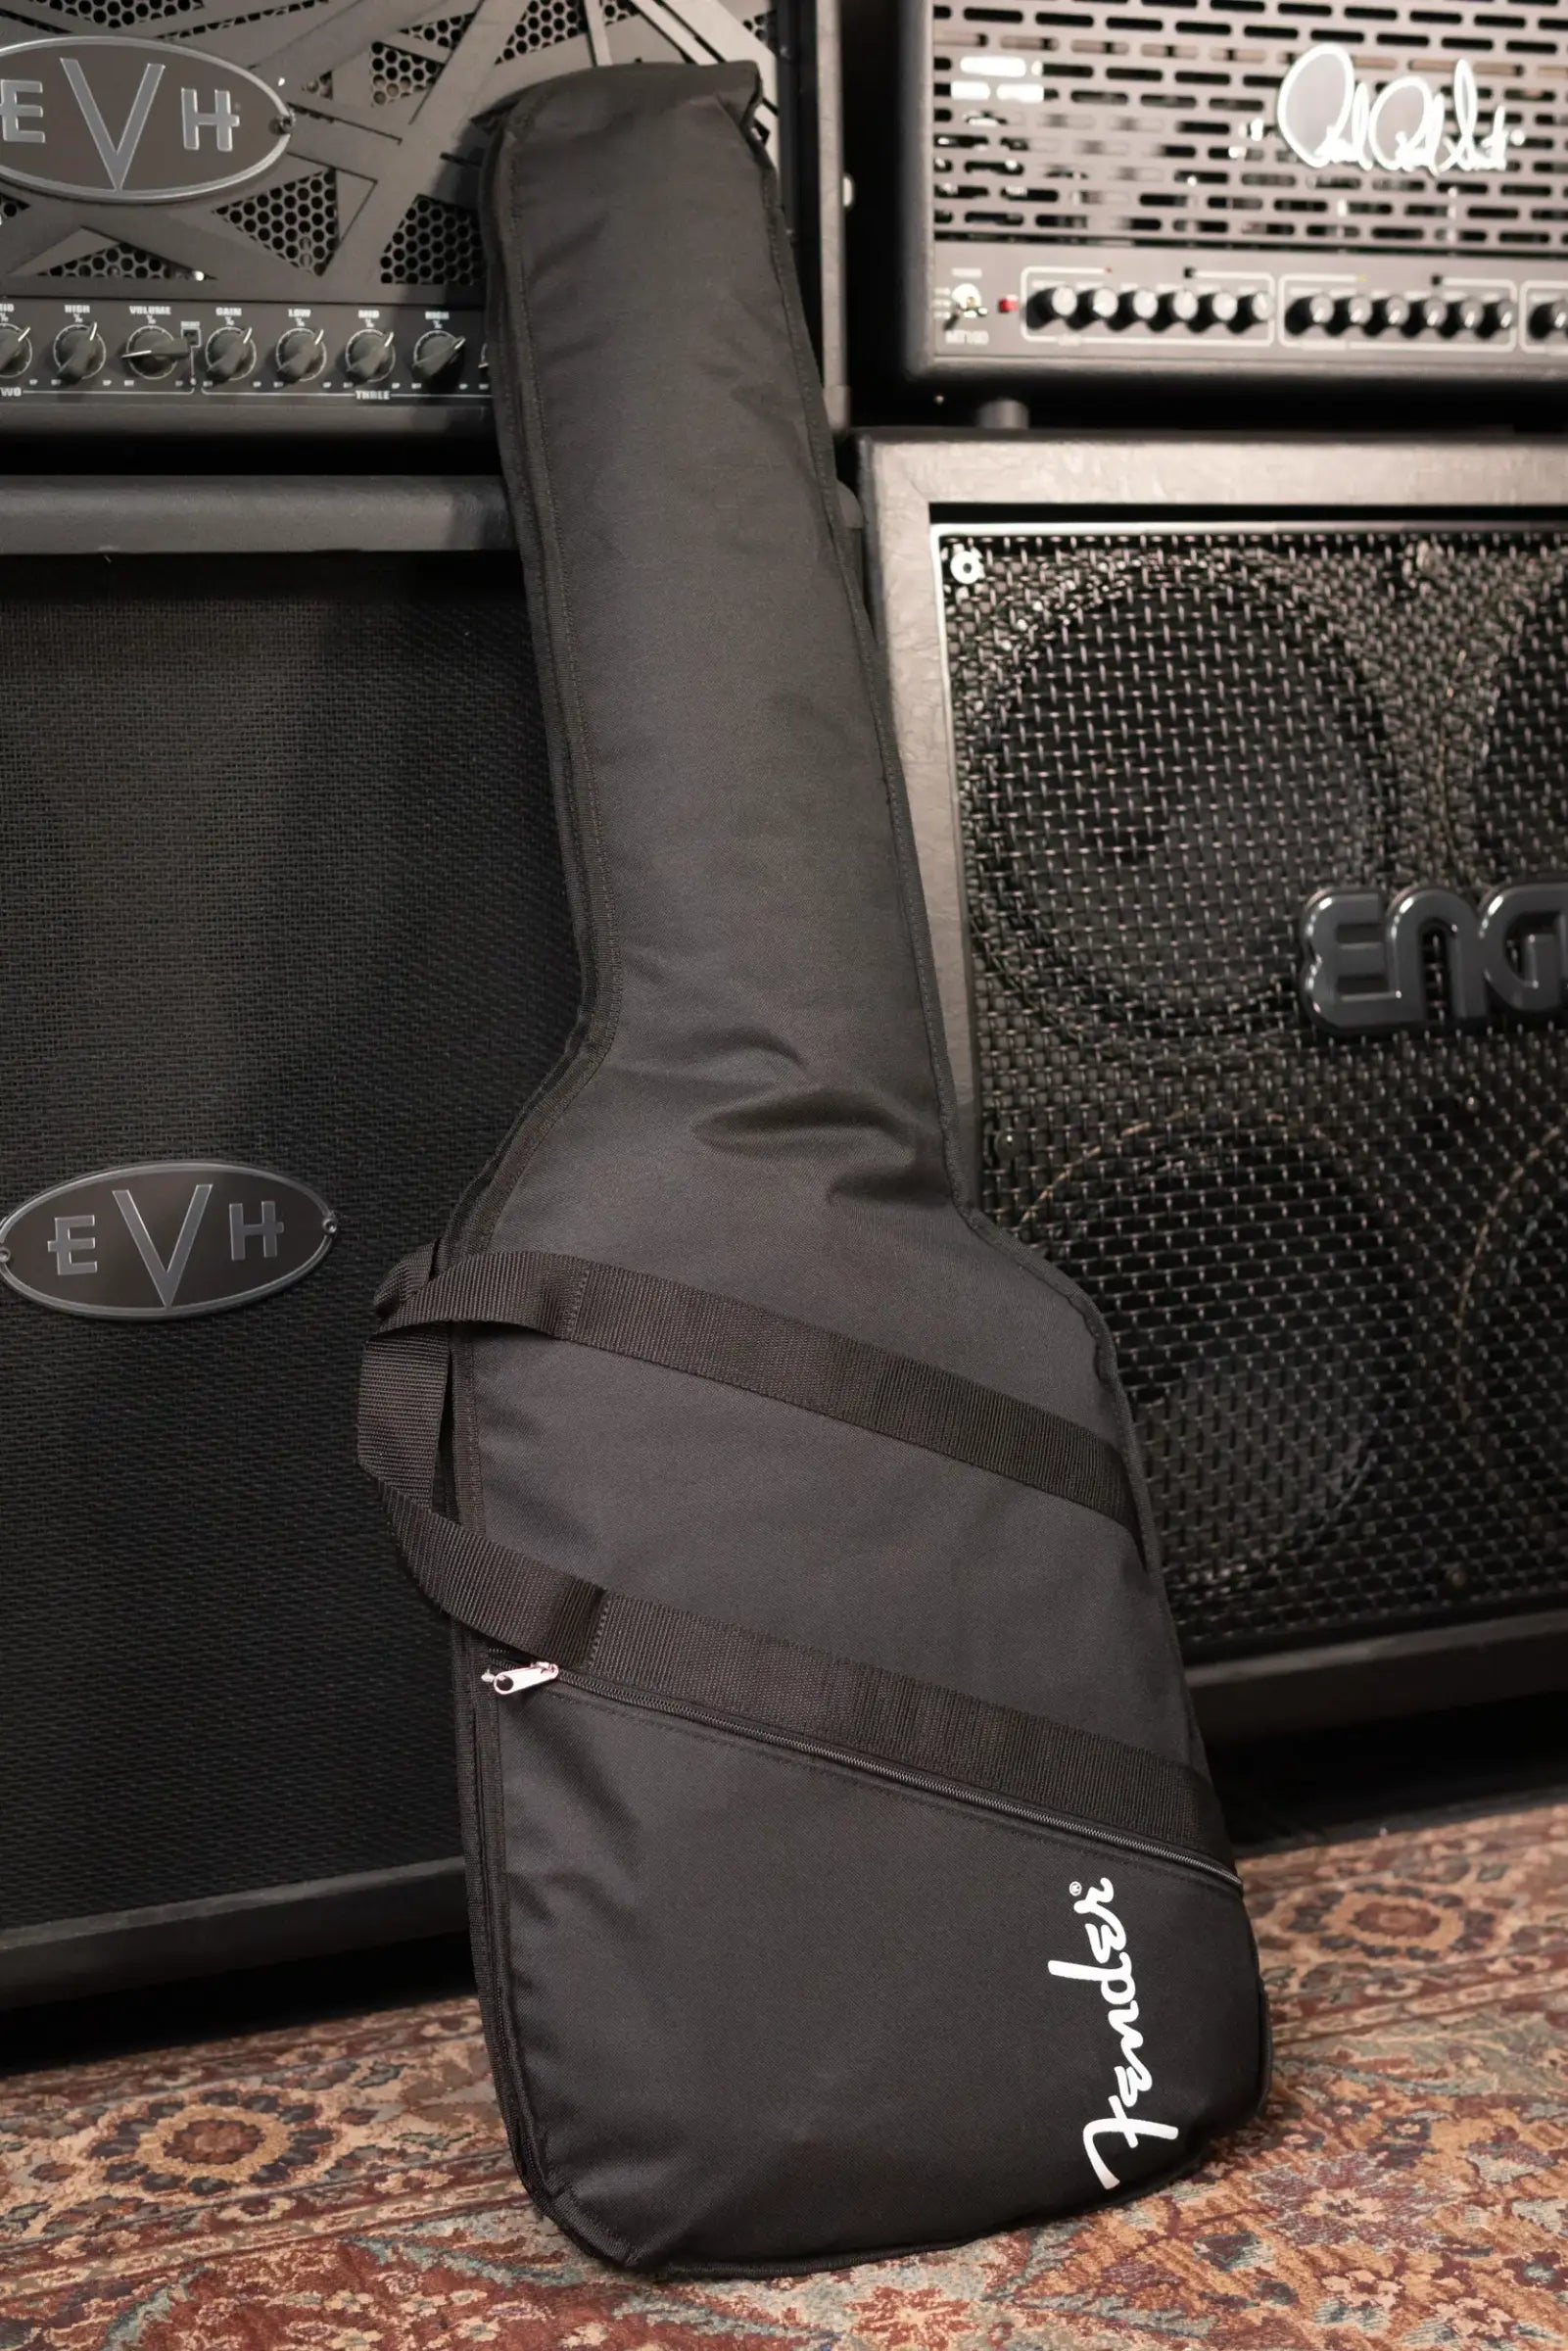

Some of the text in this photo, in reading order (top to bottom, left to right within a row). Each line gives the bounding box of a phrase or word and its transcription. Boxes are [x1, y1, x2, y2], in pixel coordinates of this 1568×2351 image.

[0, 57, 240, 193] EVH
[65, 305, 90, 313] HIGH
[129, 306, 171, 314] VOLUME
[215, 307, 242, 316] GAIN
[288, 309, 310, 317] LOW
[358, 310, 380, 318] MID
[47, 1183, 285, 1310] EVH
[1047, 1877, 1179, 2190] Fender
